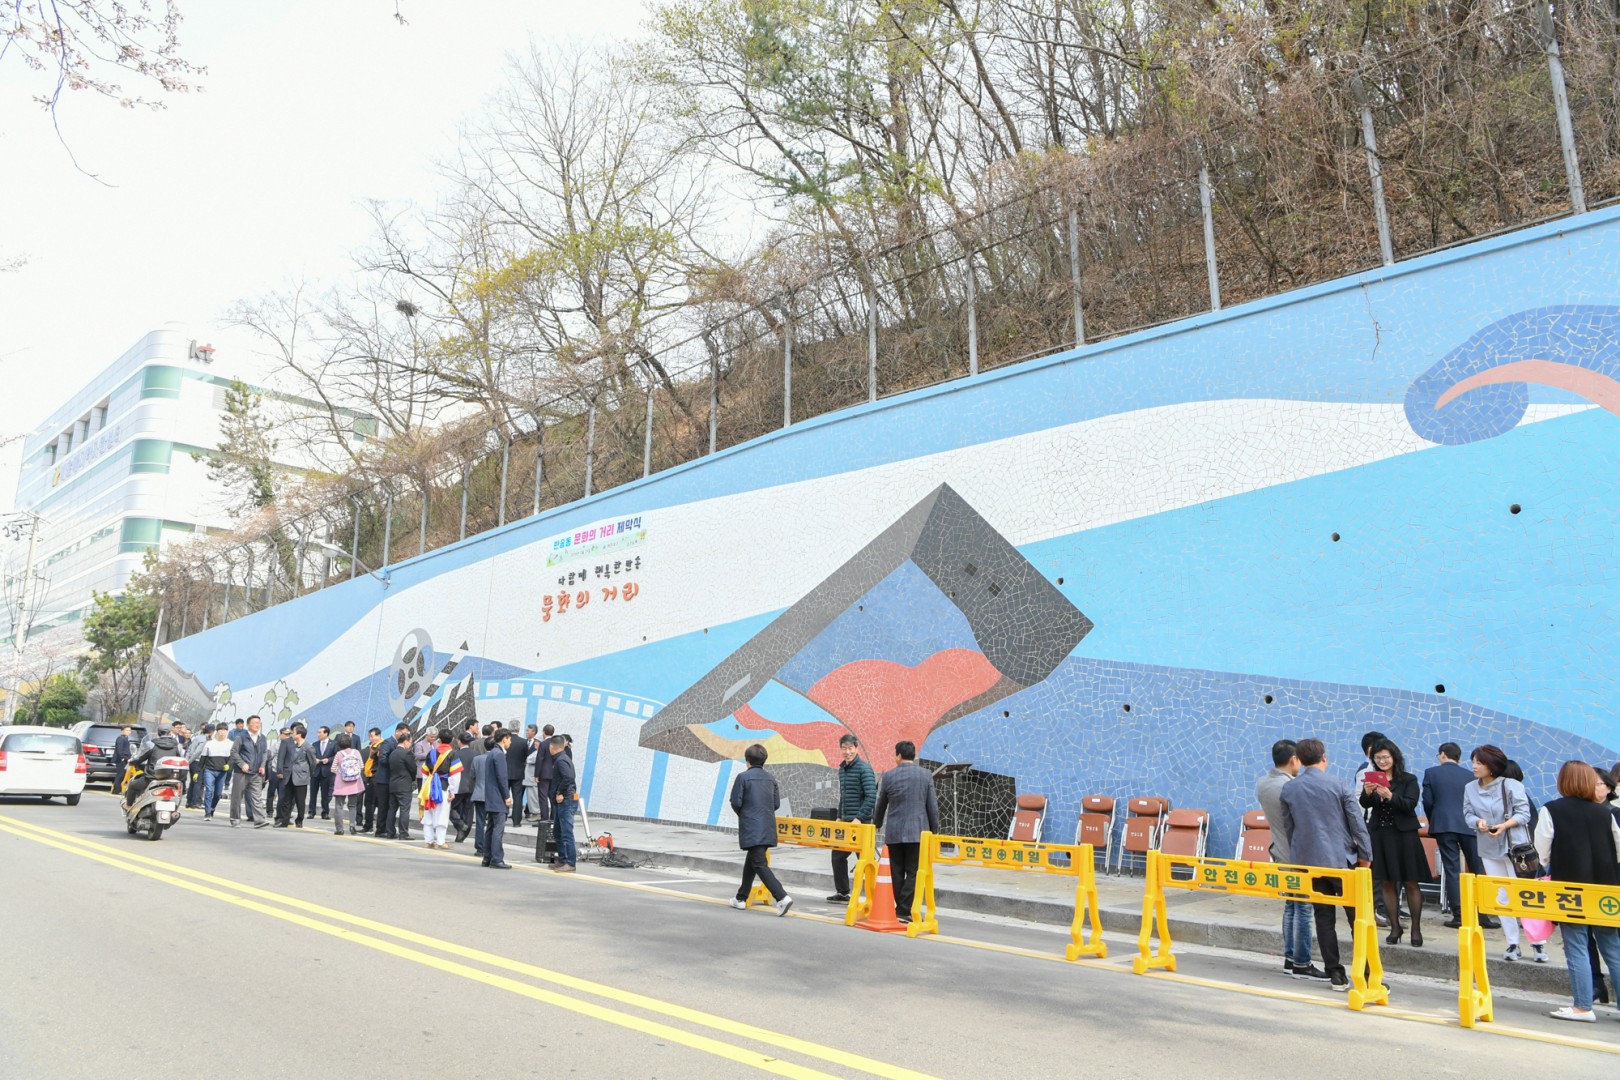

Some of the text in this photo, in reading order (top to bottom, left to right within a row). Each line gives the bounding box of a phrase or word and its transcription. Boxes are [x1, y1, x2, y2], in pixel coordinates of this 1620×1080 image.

[190, 339, 216, 364] kt
[573, 528, 597, 545] 문화의
[600, 523, 615, 538] 거리
[616, 516, 642, 534] 제막식
[594, 560, 622, 579] 행복한
[541, 582, 640, 622] 문화의 거리
[778, 823, 845, 841] 안전 제일
[965, 846, 1040, 863] 안전 제일
[1203, 868, 1301, 890] 안전 제일
[1518, 890, 1584, 912] 안전
